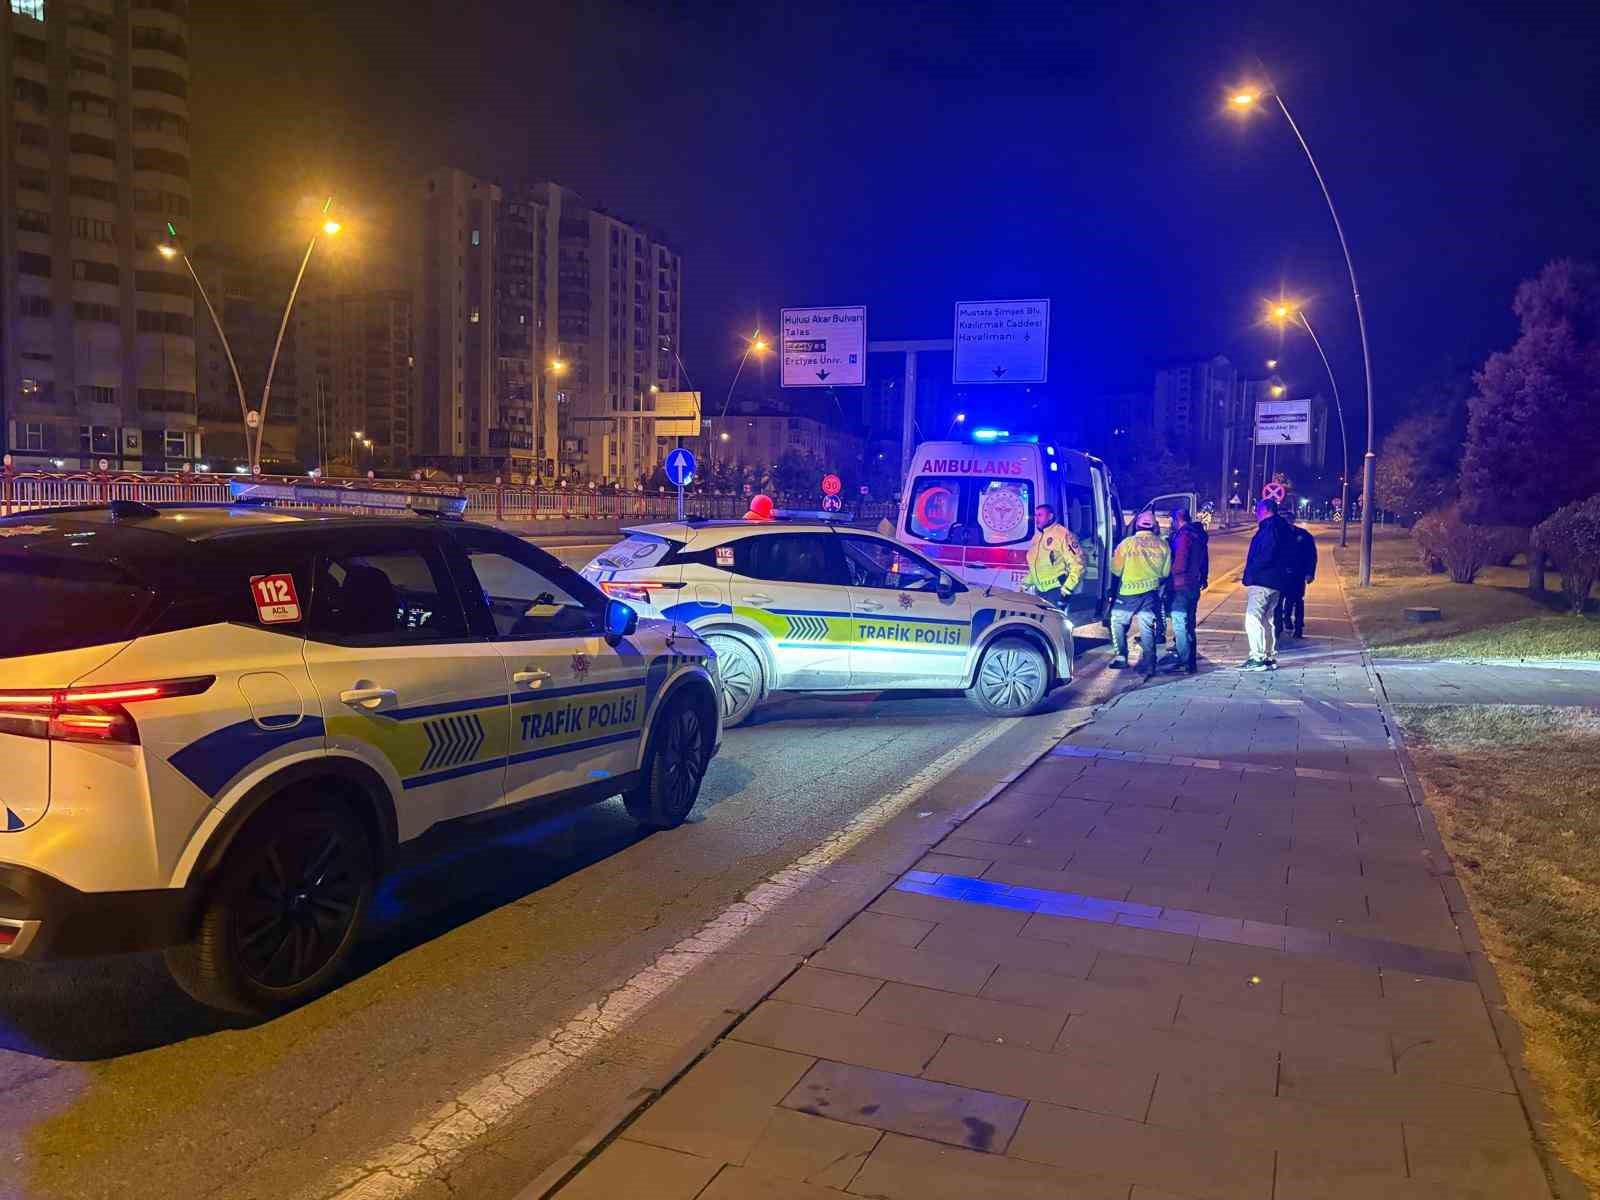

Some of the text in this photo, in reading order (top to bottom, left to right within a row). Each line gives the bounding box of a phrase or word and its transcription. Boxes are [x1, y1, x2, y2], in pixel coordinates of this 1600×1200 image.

[785, 313, 810, 325] Hulusi
[812, 313, 832, 323] Akar
[785, 327, 810, 336] Talas
[922, 459, 1023, 475] AMBULANS
[716, 547, 734, 558] 112
[258, 580, 291, 602] 112
[859, 623, 961, 646] TRAFİK POLİSİ
[520, 693, 638, 740] TRAFİK POLİSİ
